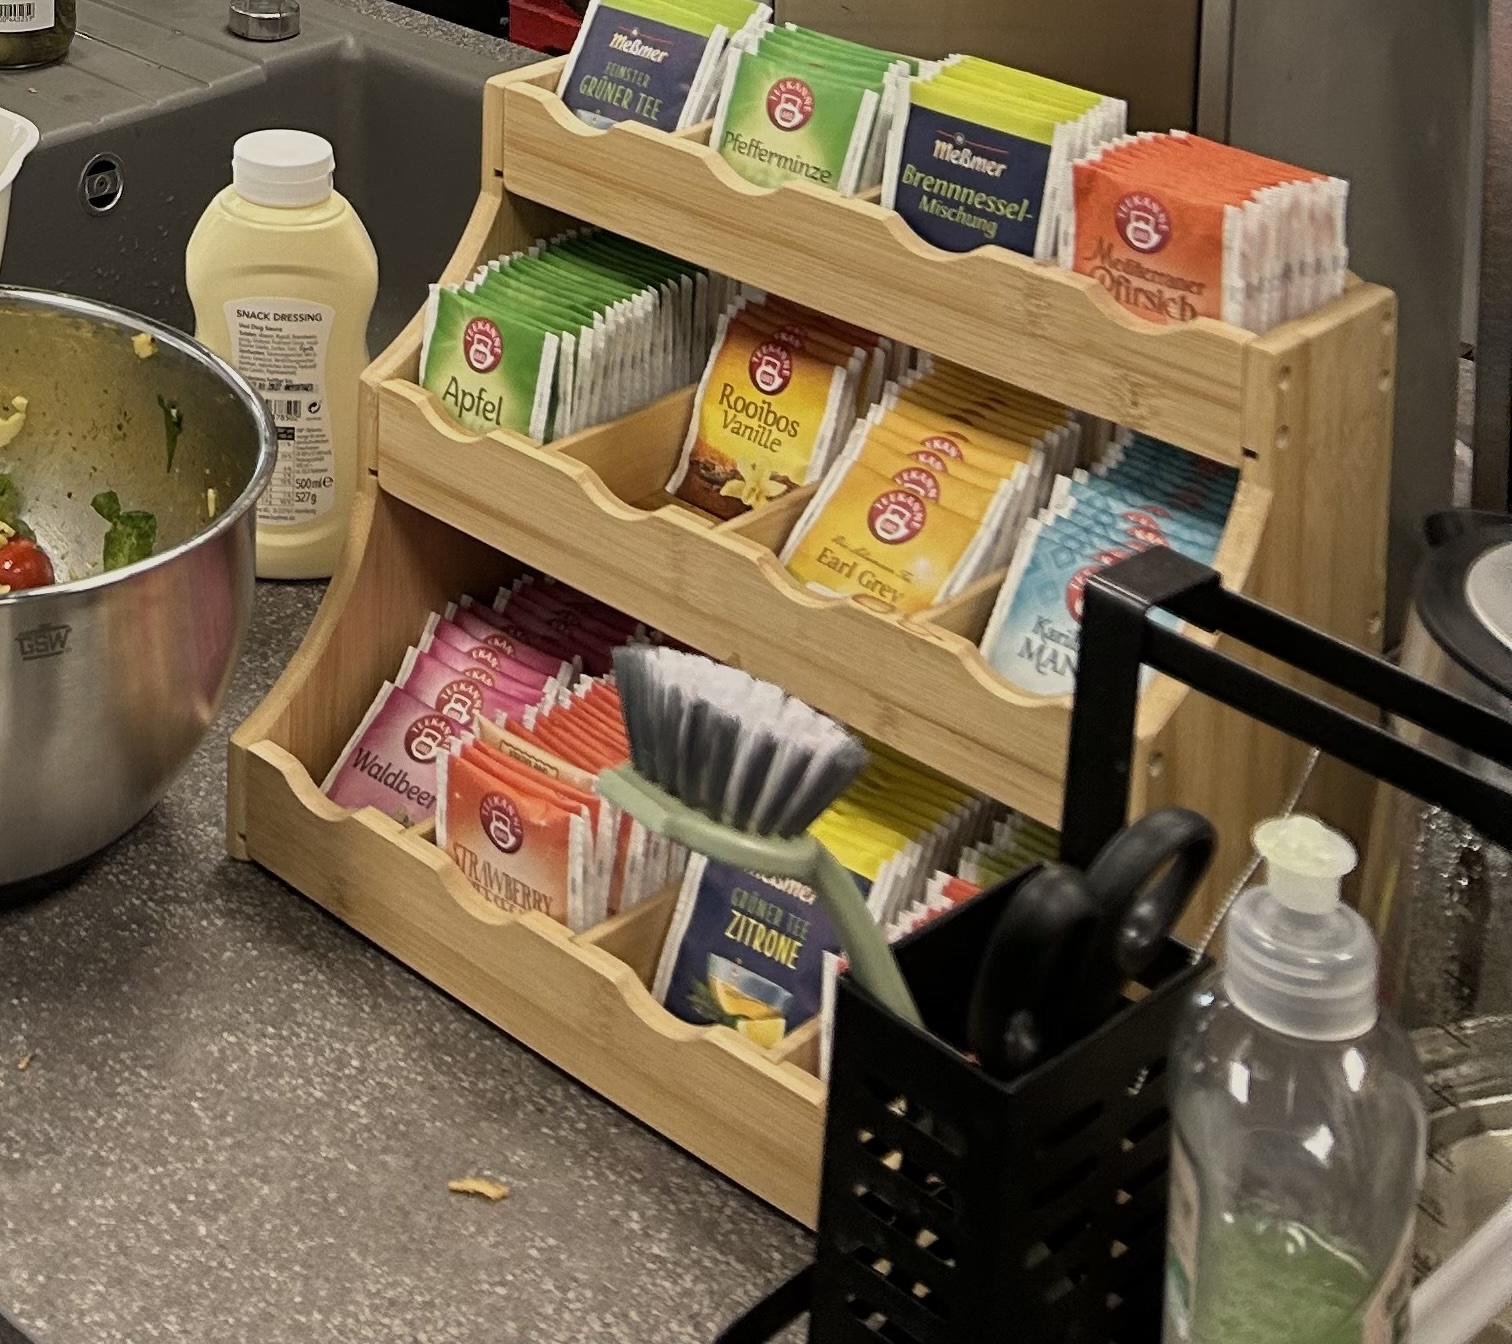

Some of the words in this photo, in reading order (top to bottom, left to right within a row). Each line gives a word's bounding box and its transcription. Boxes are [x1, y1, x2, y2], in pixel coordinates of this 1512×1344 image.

[608, 32, 669, 64] Meßmer
[579, 74, 633, 110] GRÜNER
[635, 92, 663, 121] TEE
[722, 130, 832, 184] Pfefferminze
[933, 139, 1007, 178] Meßmer
[902, 163, 1033, 222] Brennnessel-
[918, 194, 999, 239] Mischung
[236, 309, 270, 321] SNACK
[273, 312, 323, 322] DRESSING
[442, 375, 503, 425] Apfel
[718, 382, 800, 438] Rooibos
[722, 409, 782, 453] Vanille
[816, 547, 858, 578] Earl
[858, 570, 904, 603] Grey
[1017, 637, 1078, 676] MAN
[353, 747, 436, 809] Waldbeer
[453, 841, 553, 916] STRAWBERRY
[725, 909, 803, 970] ZITRONE
